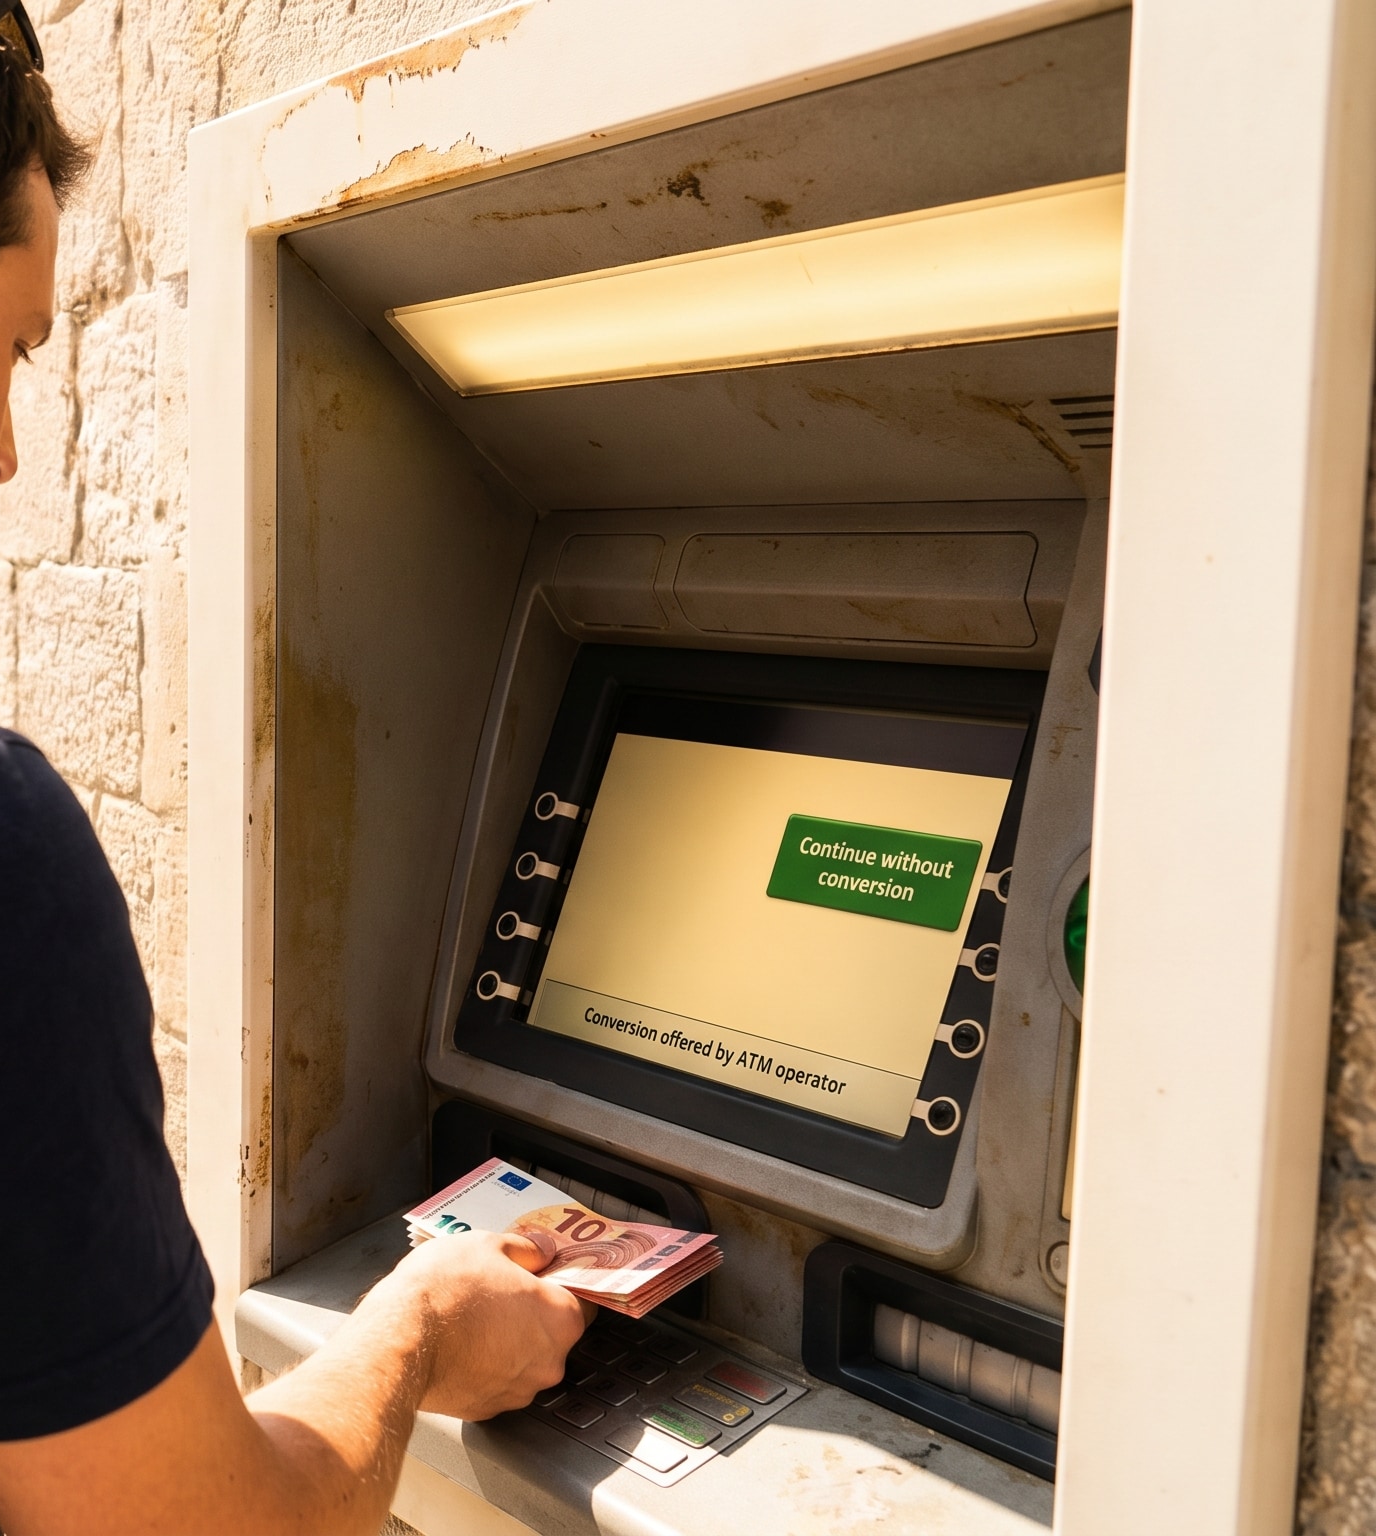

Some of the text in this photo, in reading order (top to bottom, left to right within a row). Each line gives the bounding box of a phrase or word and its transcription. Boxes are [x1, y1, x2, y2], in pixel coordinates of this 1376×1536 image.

[799, 836, 955, 879] Continue without
[818, 871, 915, 902] conversion
[584, 1007, 847, 1095] Conversion offered by ATM operator
[434, 1214, 472, 1235] 10
[554, 1207, 607, 1243] 10
